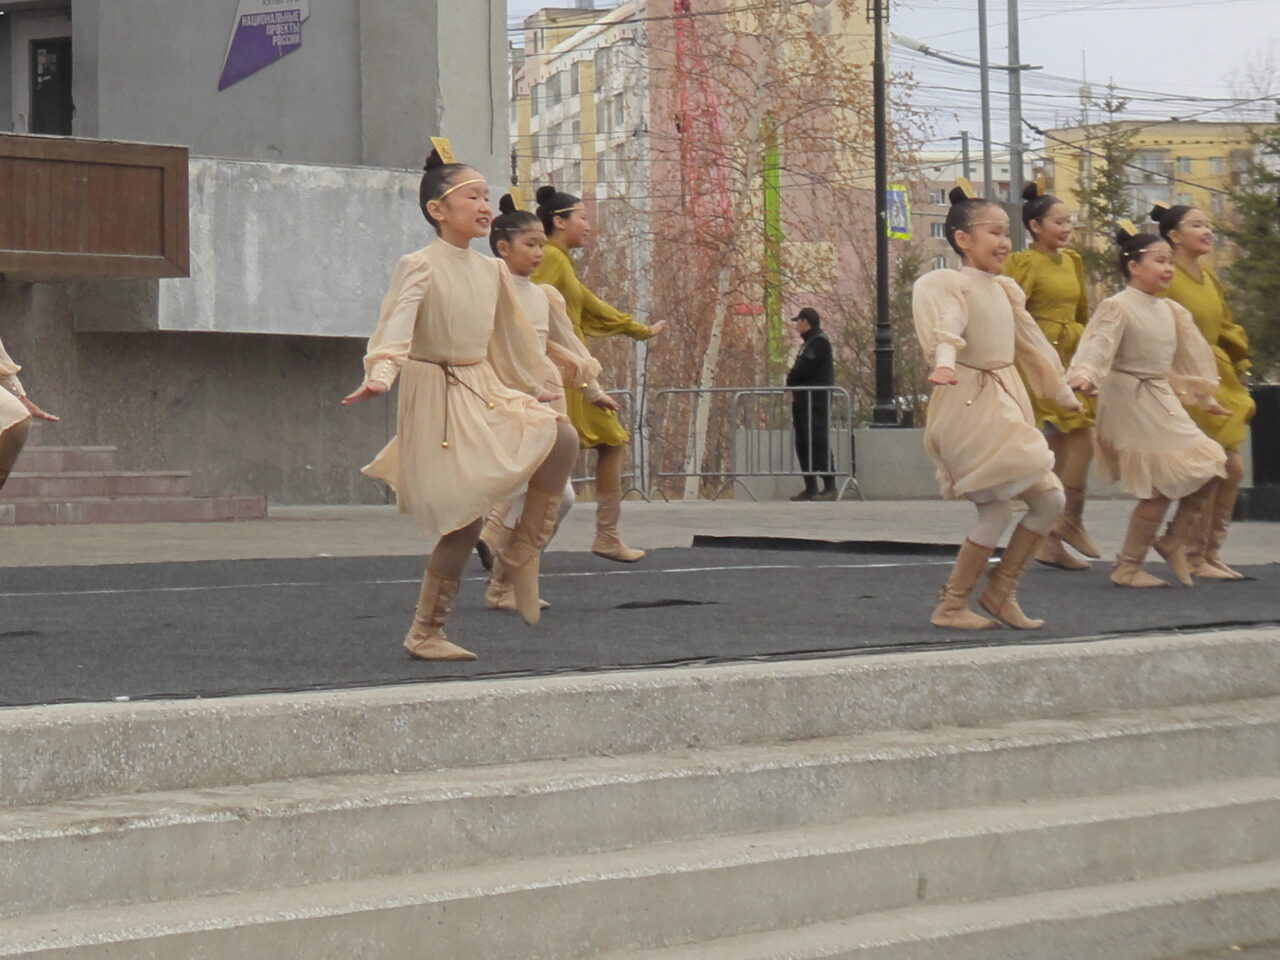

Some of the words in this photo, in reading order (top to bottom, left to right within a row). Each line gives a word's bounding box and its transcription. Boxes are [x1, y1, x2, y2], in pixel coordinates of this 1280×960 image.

[241, 10, 300, 27] НАЦИОНАЛЬНЫЕ
[266, 22, 300, 35] ПРОЕКТЫ
[272, 34, 300, 47] РОССИИ
